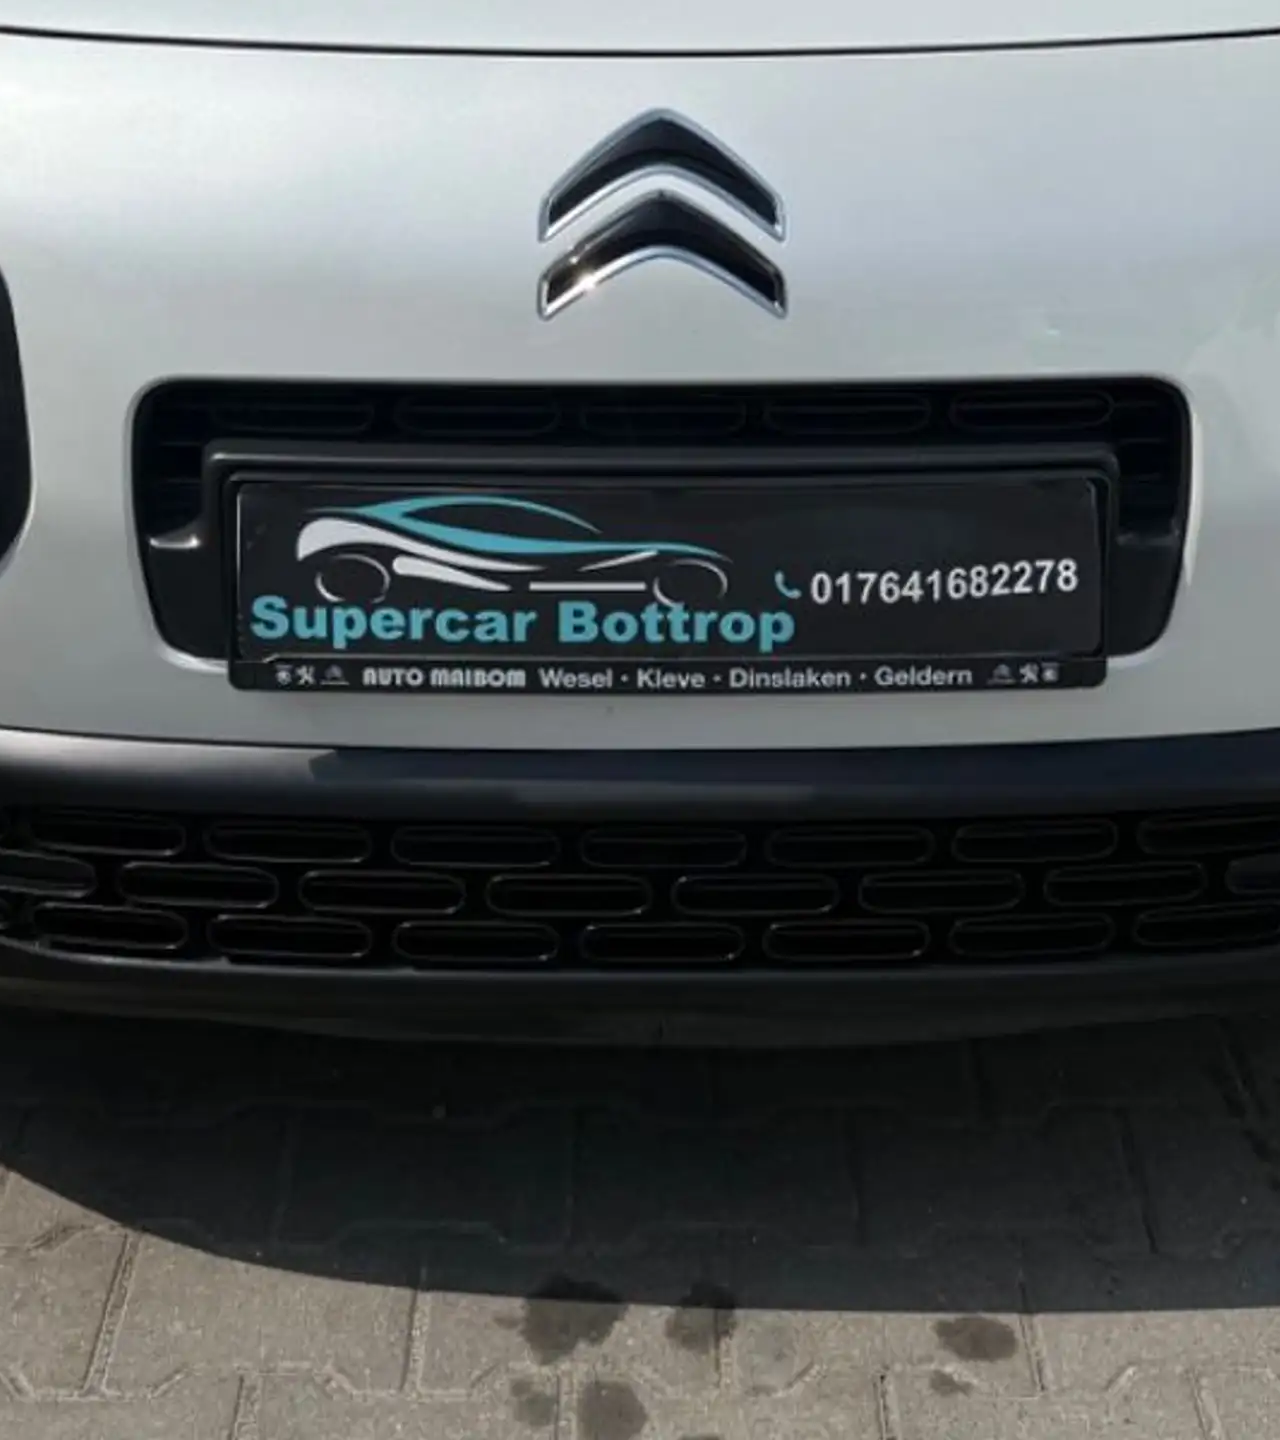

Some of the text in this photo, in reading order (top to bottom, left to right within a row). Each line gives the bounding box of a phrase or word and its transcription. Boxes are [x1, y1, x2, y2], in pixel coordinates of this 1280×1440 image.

[810, 558, 1078, 605] 017641682278
[250, 594, 795, 653] Supercar Bottrop
[362, 665, 972, 689] AUTO MAIBOM Wesel Kleve Dinslaken Geldern
